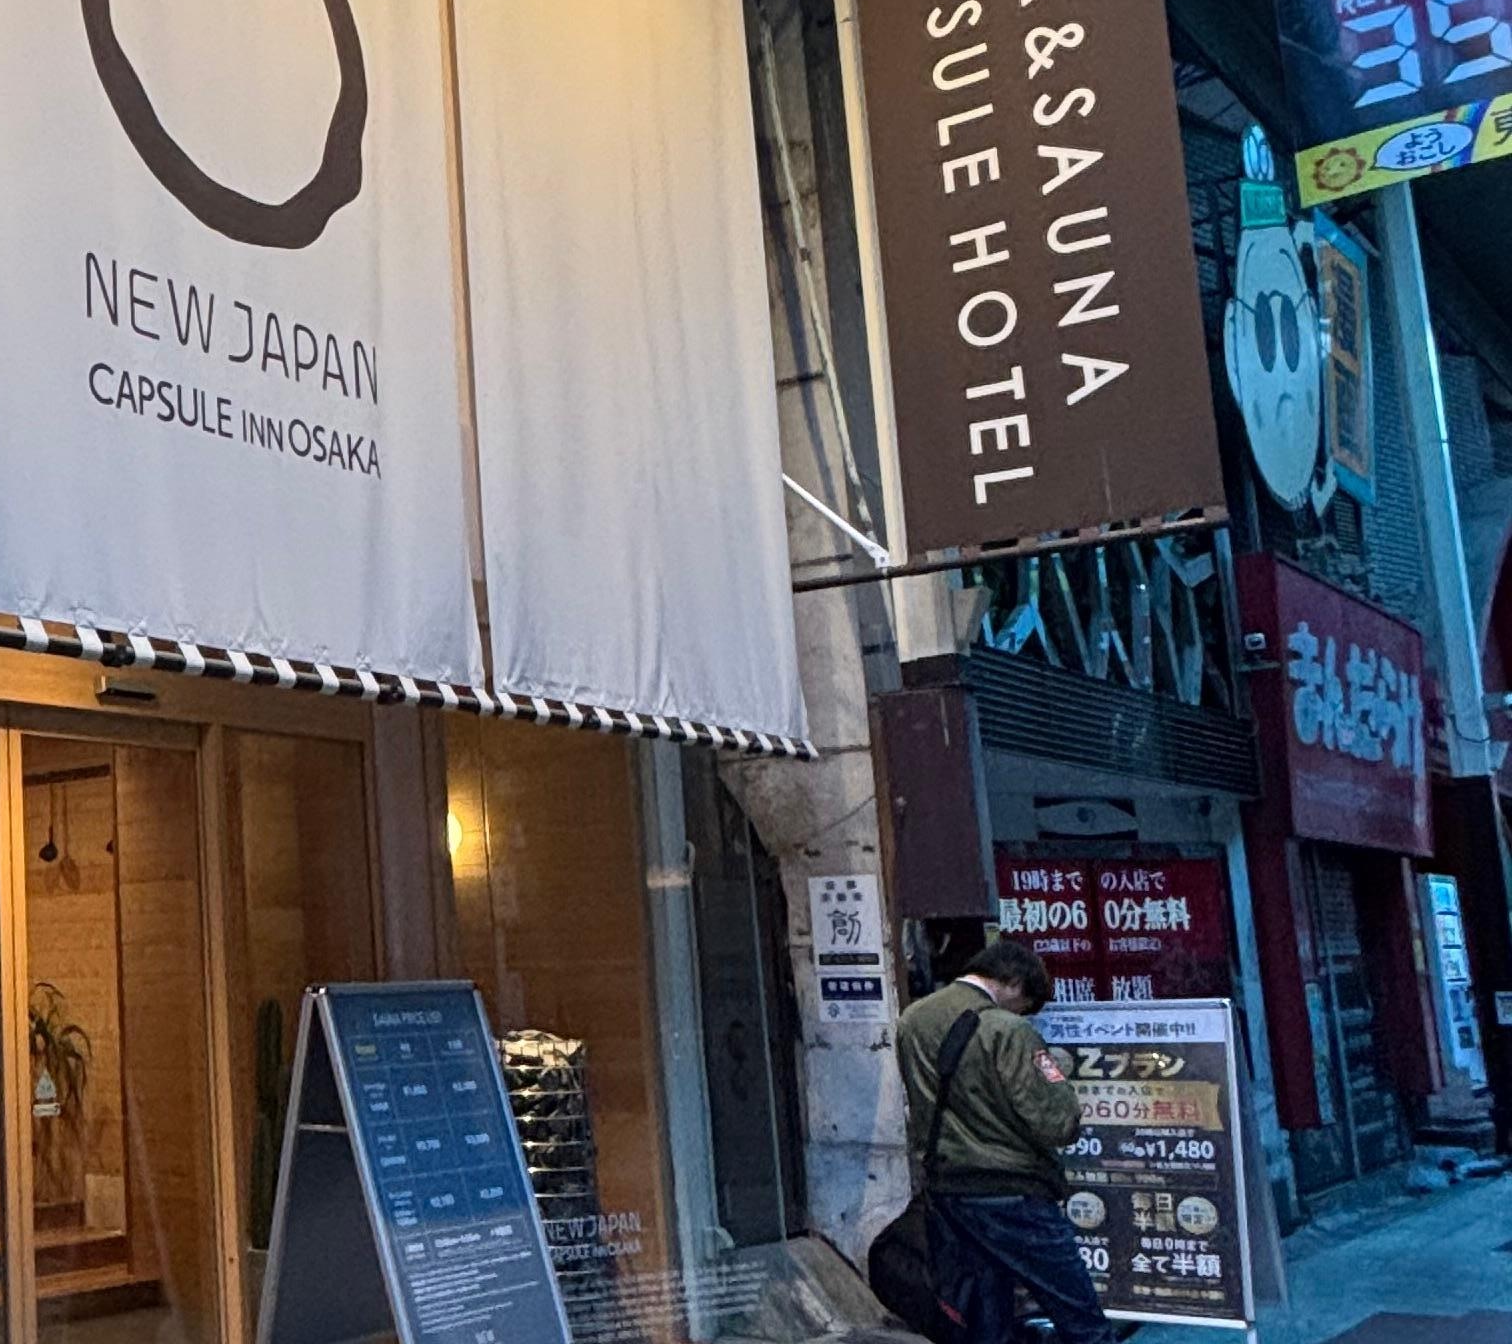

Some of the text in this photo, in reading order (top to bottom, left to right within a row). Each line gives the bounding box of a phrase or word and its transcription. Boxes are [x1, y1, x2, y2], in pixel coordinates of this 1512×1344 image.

[1404, 128, 1442, 150] よう
[85, 252, 378, 405] NEW JAPAN
[949, 220, 1035, 505] HOTEL
[88, 362, 234, 438] CAPSULE
[1131, 1252, 1222, 1278] 全て半額
